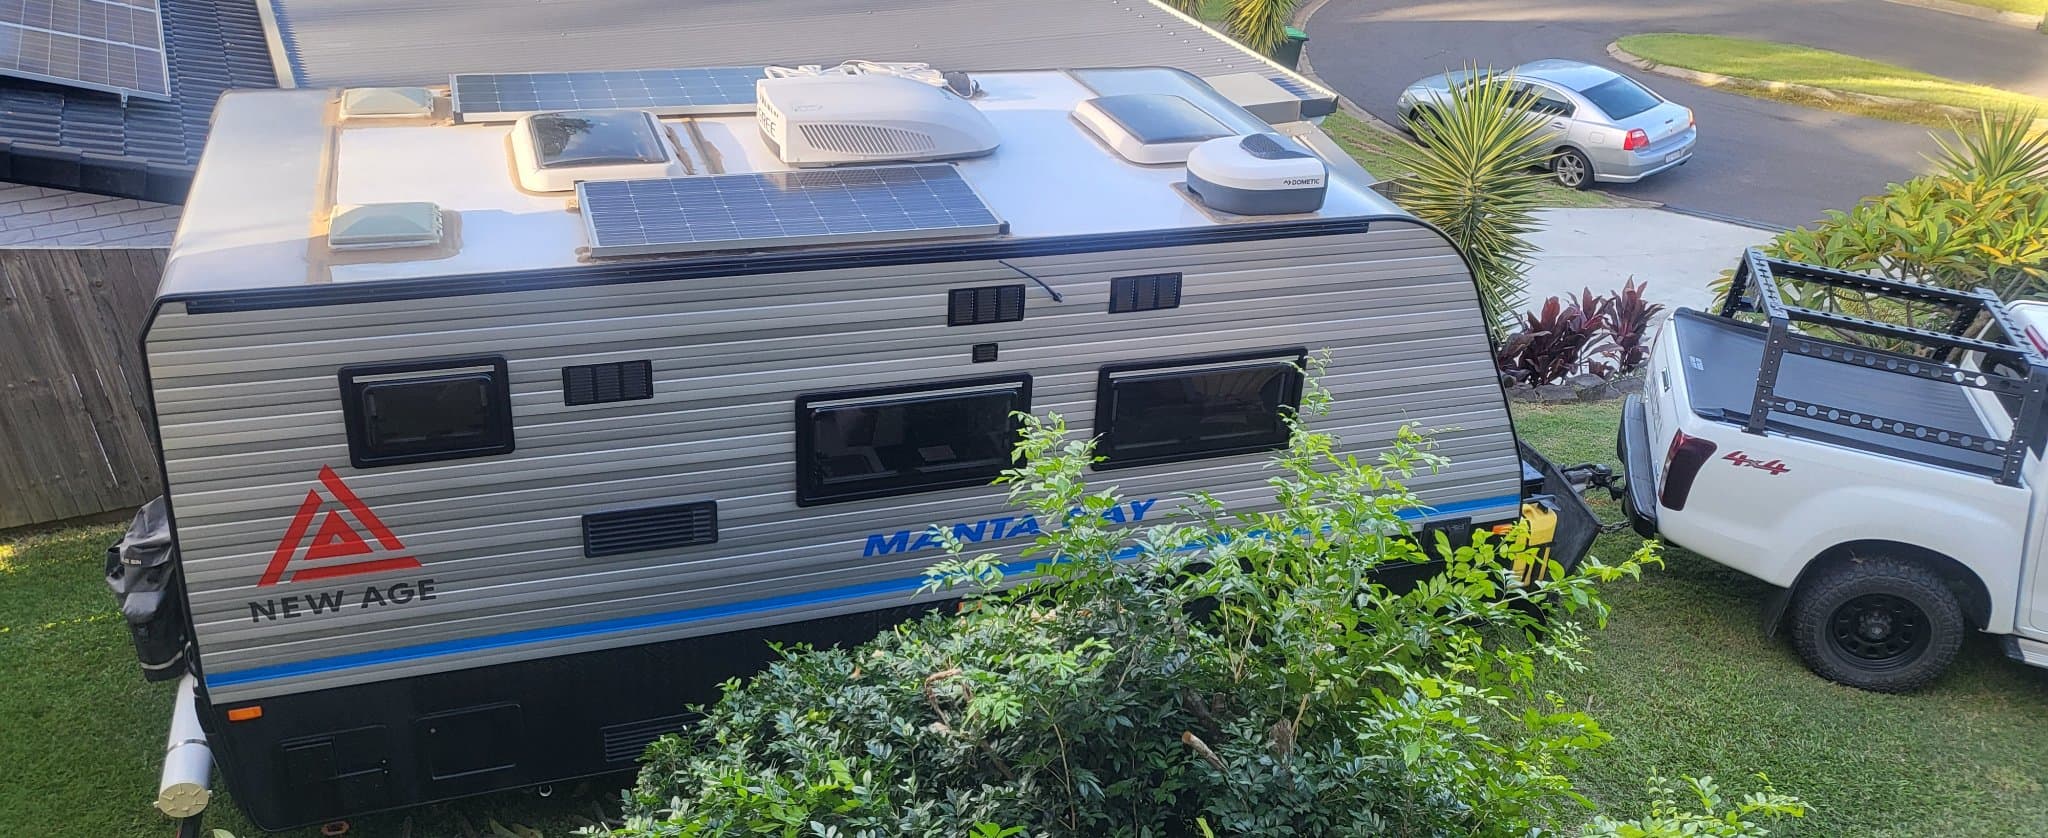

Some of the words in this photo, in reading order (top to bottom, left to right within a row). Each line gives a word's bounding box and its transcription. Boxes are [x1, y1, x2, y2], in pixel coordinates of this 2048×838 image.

[1291, 178, 1320, 186] DOMETIC
[862, 513, 1042, 558] MANTA
[248, 590, 345, 623] NEW
[361, 578, 437, 609] AGE
